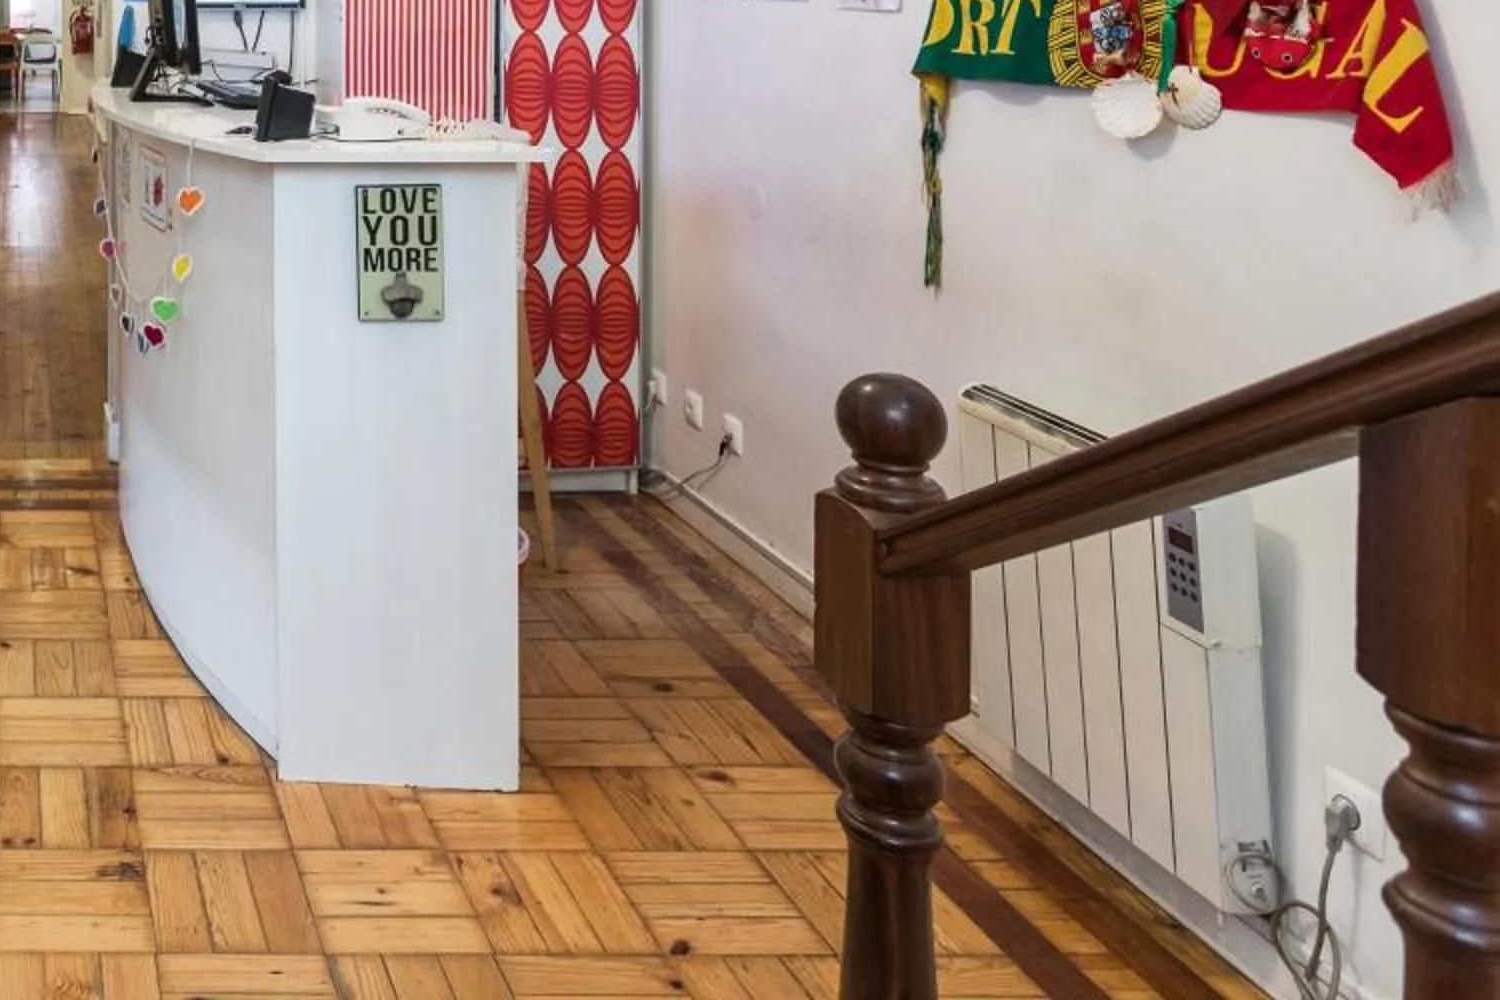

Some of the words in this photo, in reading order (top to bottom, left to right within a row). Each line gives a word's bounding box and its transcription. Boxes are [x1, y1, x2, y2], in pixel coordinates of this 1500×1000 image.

[361, 187, 438, 214] LOVE
[361, 215, 438, 246] YOU
[363, 247, 439, 273] MORE
